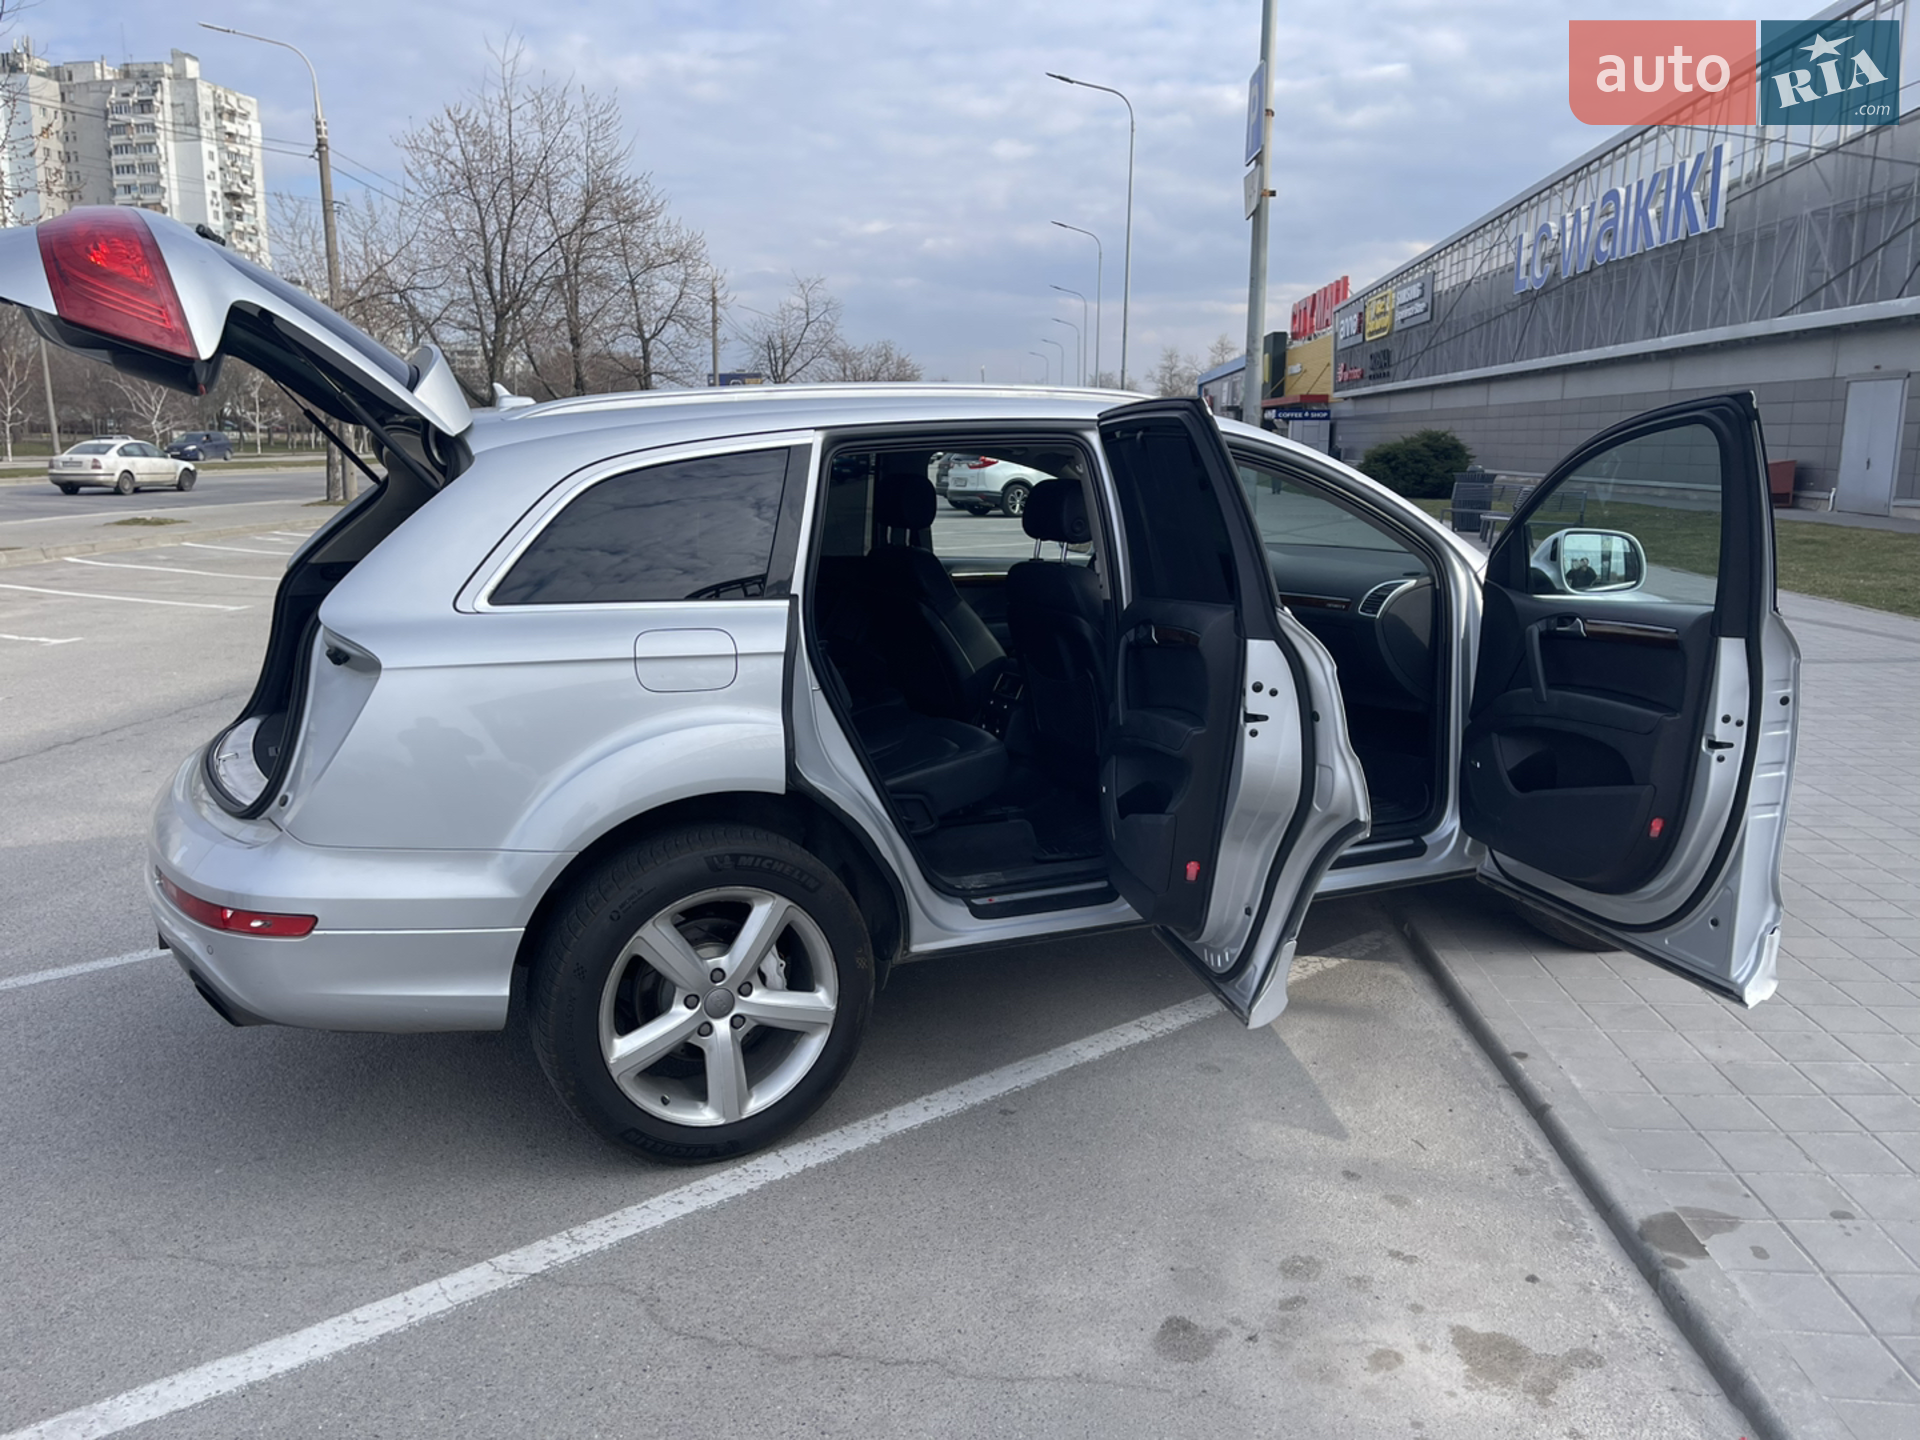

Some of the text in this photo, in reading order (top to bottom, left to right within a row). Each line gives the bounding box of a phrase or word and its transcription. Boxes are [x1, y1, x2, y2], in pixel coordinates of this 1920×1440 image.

[1249, 83, 1259, 150] P
[1513, 220, 1557, 295] LC
[1291, 293, 1317, 340] CITY
[737, 856, 820, 889] MICHELIN
